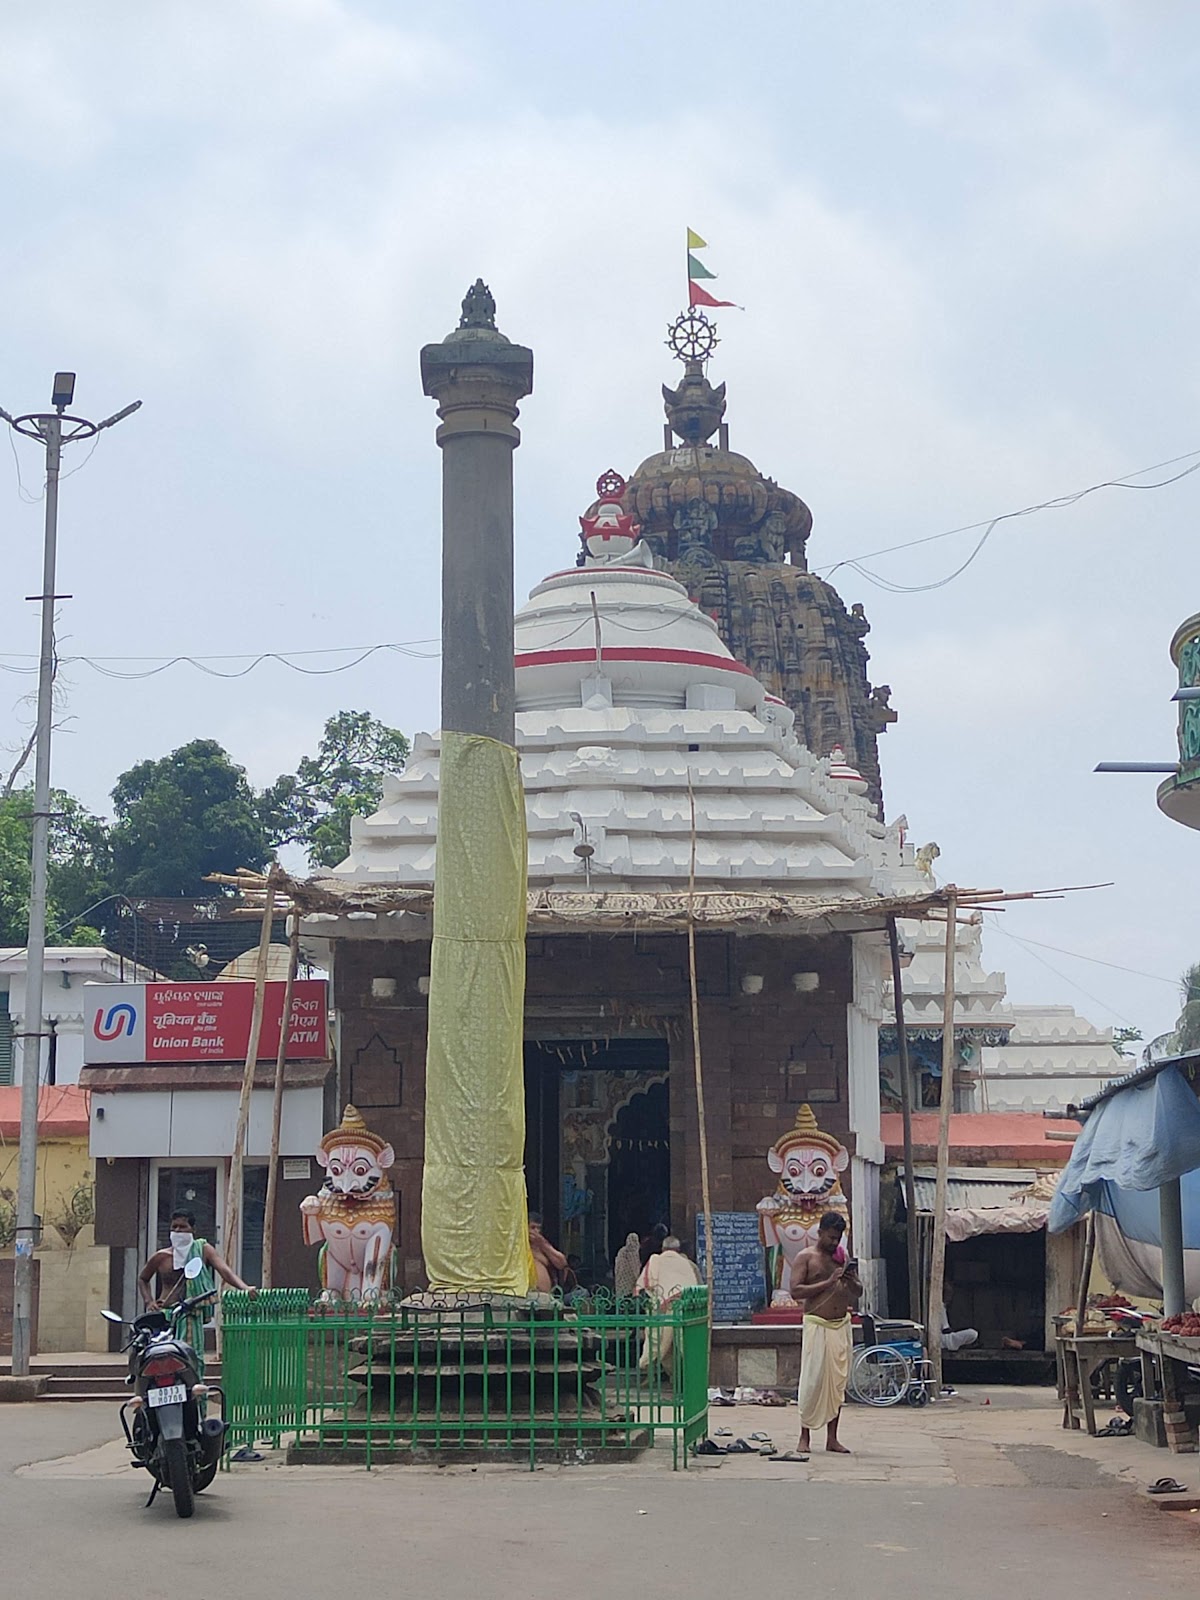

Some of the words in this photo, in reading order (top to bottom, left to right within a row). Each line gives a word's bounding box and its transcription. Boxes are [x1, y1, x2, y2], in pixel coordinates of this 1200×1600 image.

[284, 998, 319, 1010] ଟିଏମ
[153, 1012, 196, 1029] यूनियन
[197, 1012, 217, 1025] बैंक
[153, 1037, 189, 1048] Union
[191, 1036, 224, 1047] Bank
[289, 1031, 319, 1043] ATM
